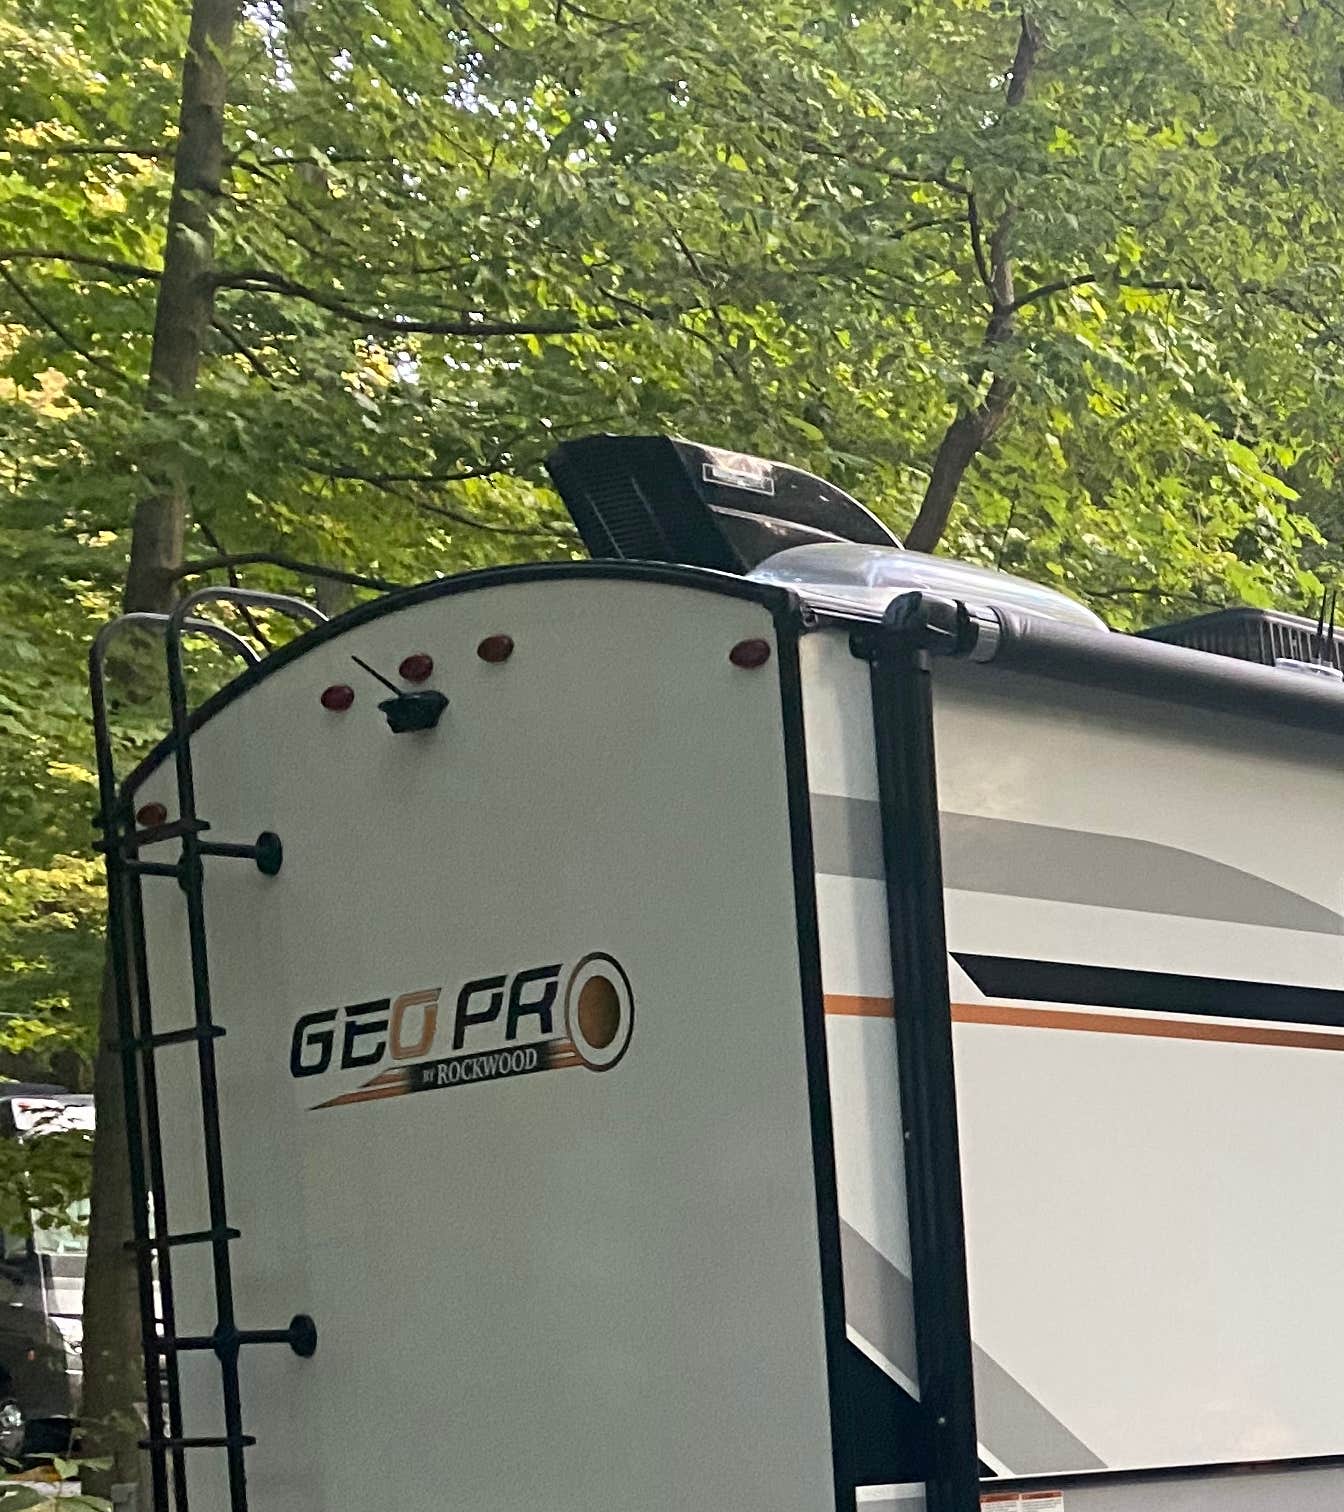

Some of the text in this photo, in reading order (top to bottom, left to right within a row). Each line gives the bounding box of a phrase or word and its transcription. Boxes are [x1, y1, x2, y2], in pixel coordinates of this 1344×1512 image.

[290, 987, 442, 1078] GEO
[422, 1048, 538, 1085] BY ROCKWOOD
